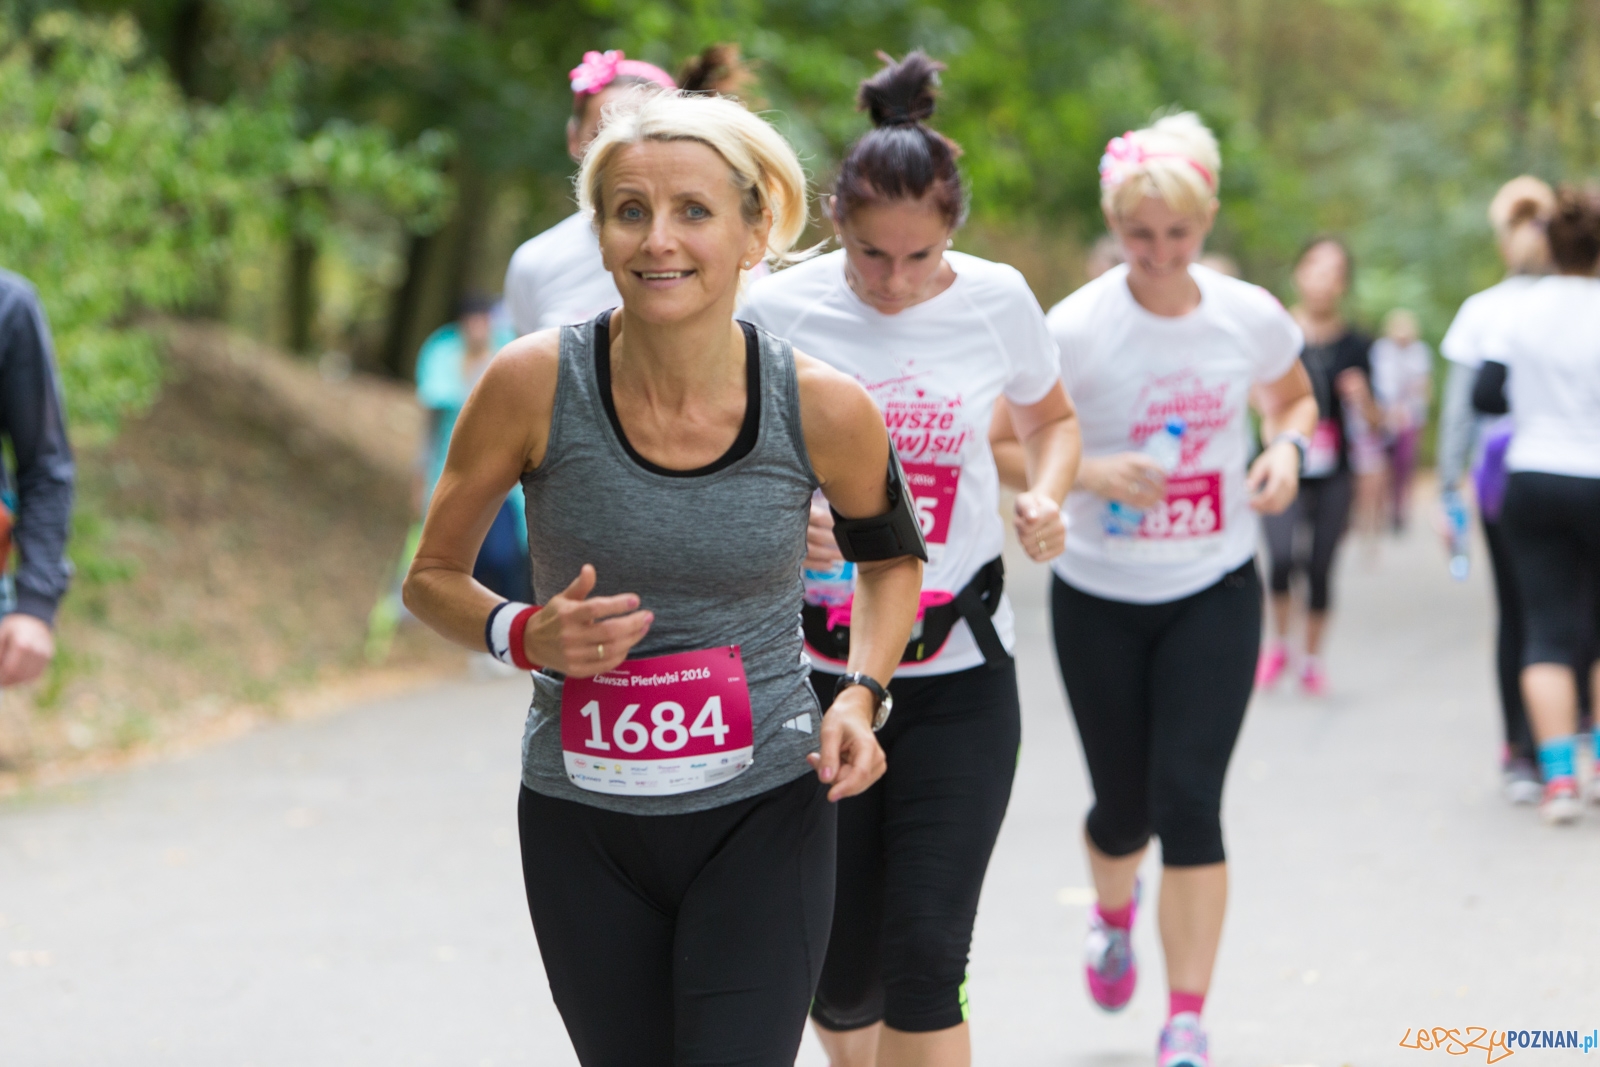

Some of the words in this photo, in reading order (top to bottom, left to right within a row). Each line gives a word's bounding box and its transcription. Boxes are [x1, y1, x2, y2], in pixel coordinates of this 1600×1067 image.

[885, 412, 954, 431] wsze
[630, 670, 680, 687] Pier(w)si
[681, 666, 711, 682] 2016
[580, 695, 730, 753] 1684
